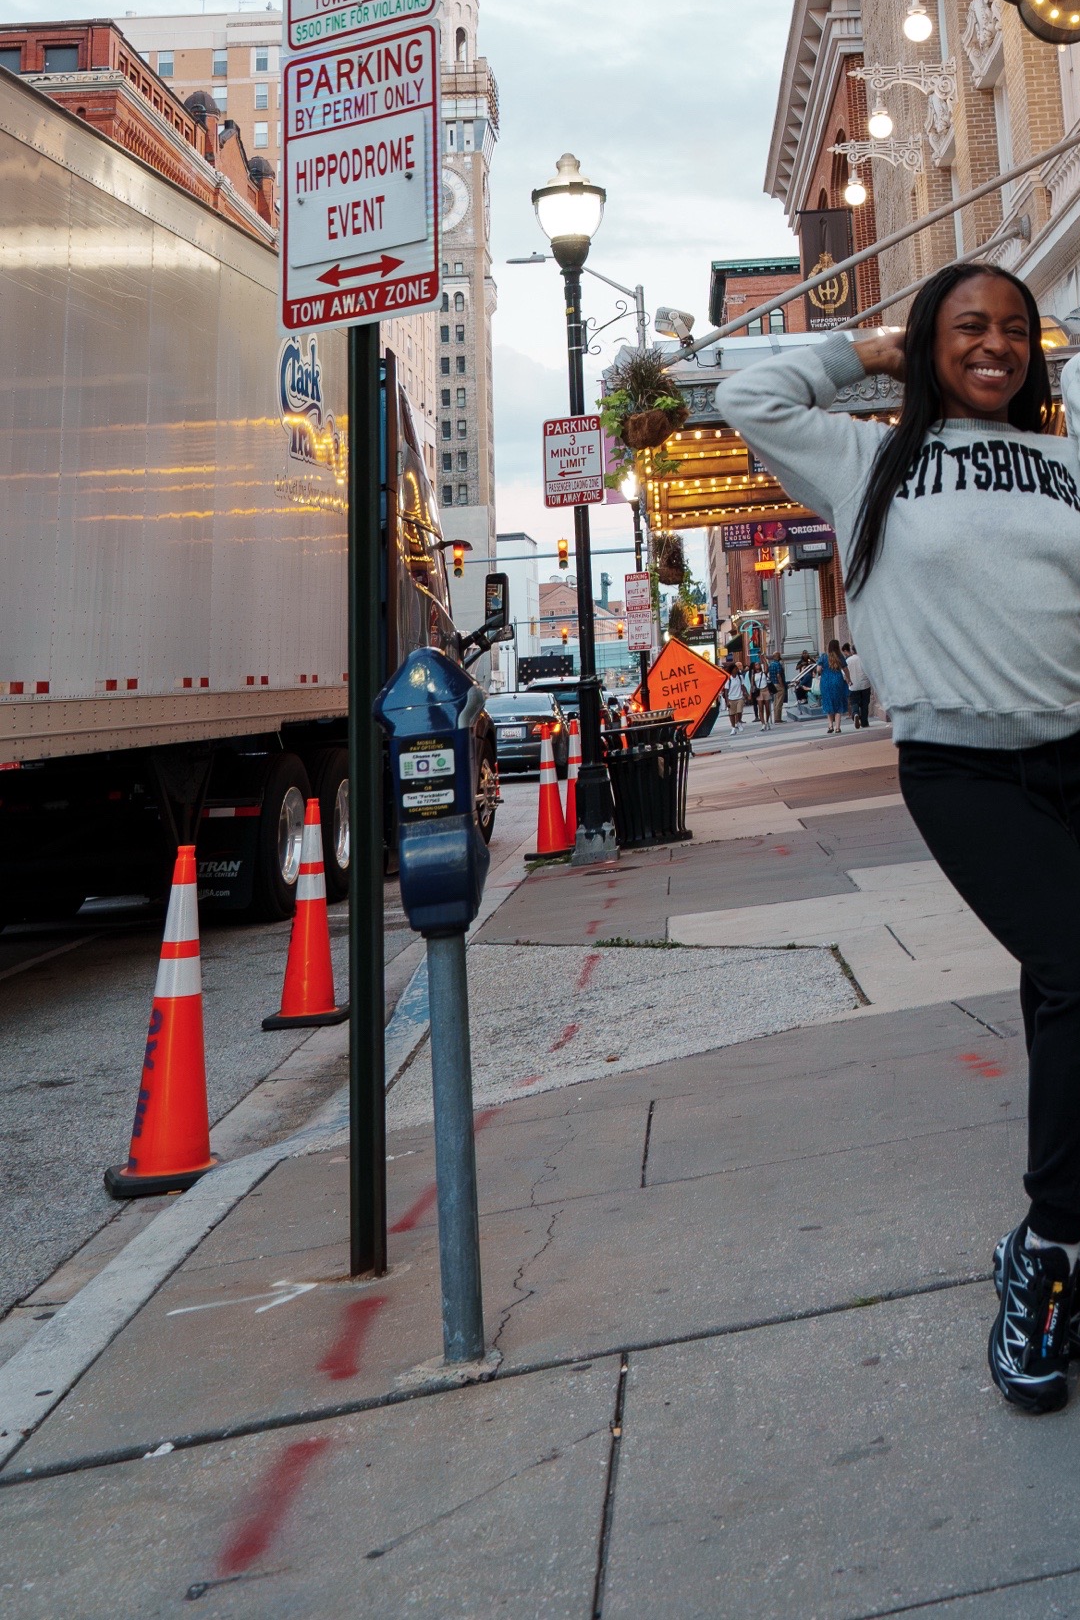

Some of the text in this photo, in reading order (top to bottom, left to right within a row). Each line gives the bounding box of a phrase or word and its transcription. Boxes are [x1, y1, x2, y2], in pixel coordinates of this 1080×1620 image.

[296, 19, 322, 42] $500
[325, 11, 347, 31] FINE
[349, 5, 371, 24] FOR
[296, 39, 423, 102] PARKING
[295, 78, 424, 132] BY PERMIT ONLY
[296, 134, 415, 194] HIPPODROME
[327, 195, 385, 240] EVENT
[291, 278, 431, 325] TOW AWAY ZONE
[546, 418, 597, 435] PARKING
[569, 435, 576, 446] 3
[551, 445, 595, 458] MINUTE
[560, 457, 587, 469] LIMIT
[549, 478, 599, 493] PASSENGER LOADING ZONE
[548, 490, 600, 505] TOW AWAY ZONE
[626, 573, 647, 581] PARKING
[660, 664, 696, 681] LANE
[662, 679, 699, 697] SHIFT
[667, 695, 702, 709] AHEAD
[199, 861, 243, 872] TRAN
